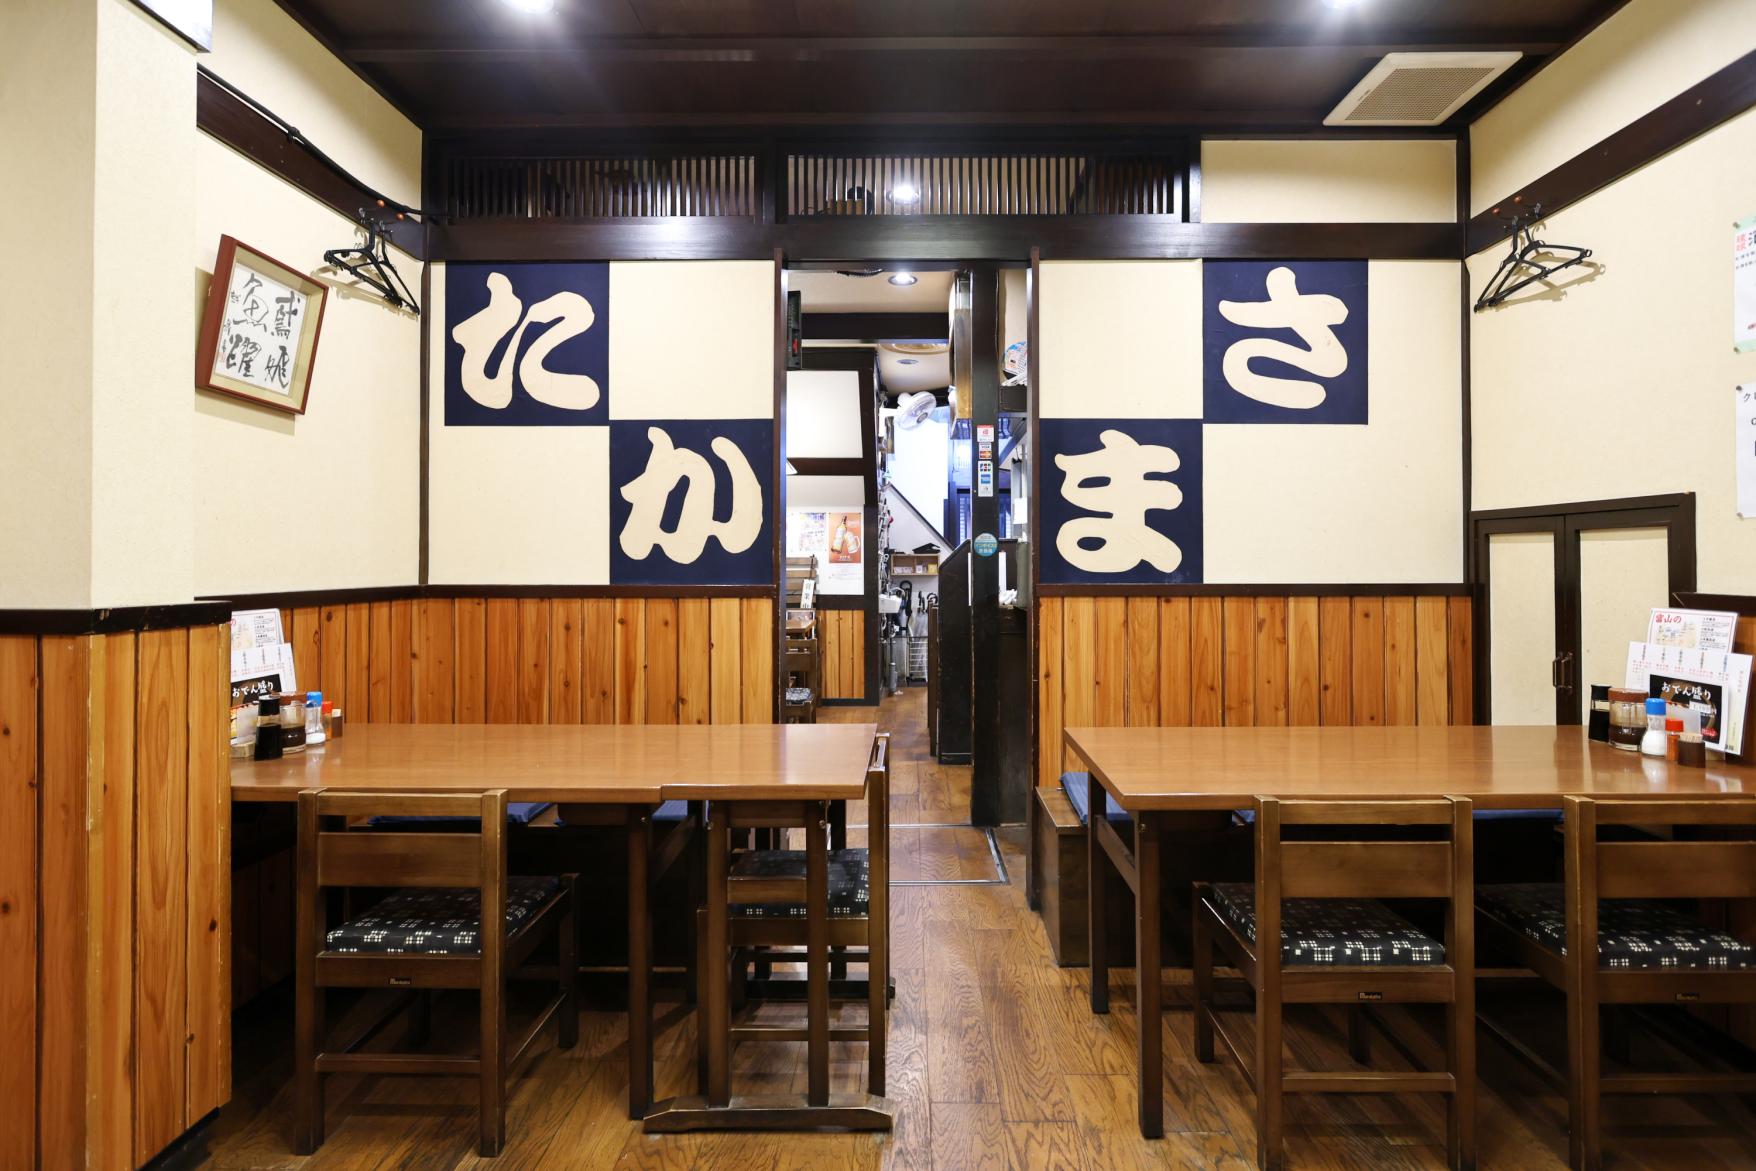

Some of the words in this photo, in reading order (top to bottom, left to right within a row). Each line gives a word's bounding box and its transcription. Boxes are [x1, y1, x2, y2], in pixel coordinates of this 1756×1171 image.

[1655, 613, 1682, 624] 富山の
[232, 680, 274, 697] おでん盛り
[1661, 681, 1712, 700] おでん盛り
